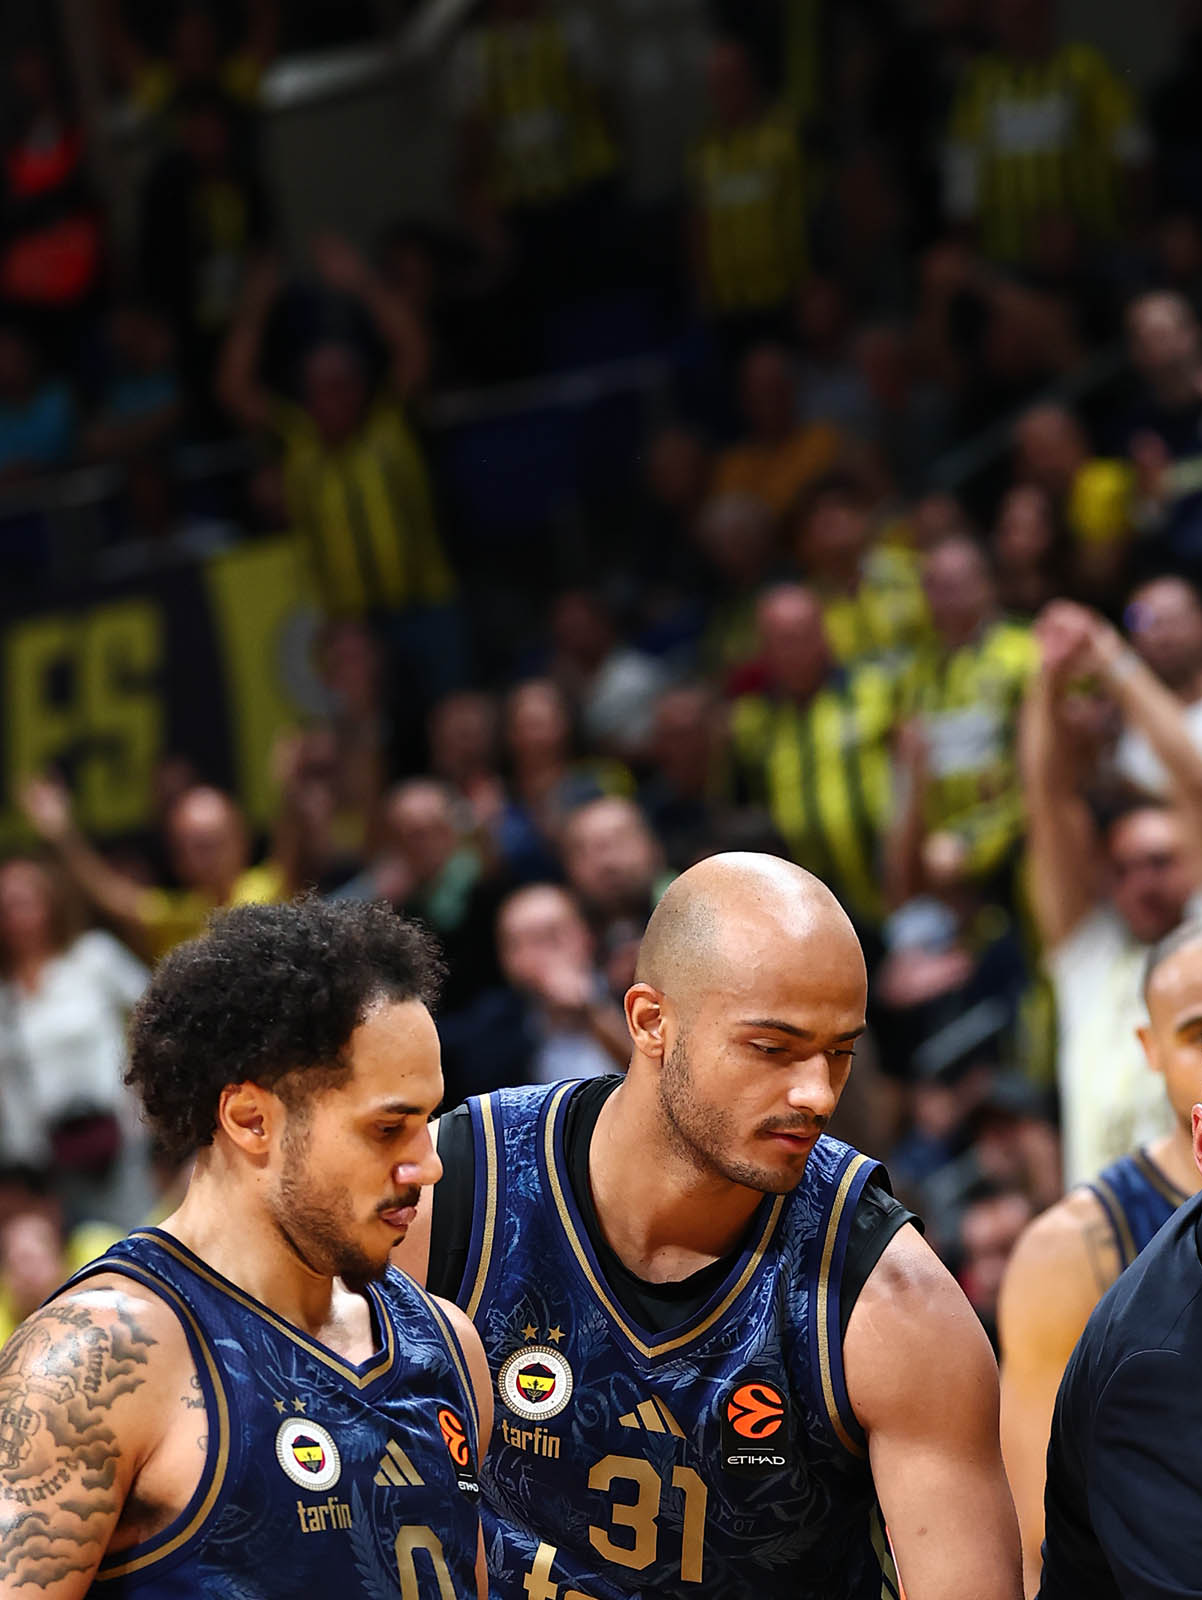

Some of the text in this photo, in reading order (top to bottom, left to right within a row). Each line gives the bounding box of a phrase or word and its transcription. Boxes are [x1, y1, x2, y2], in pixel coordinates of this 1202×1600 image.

[502, 1419, 560, 1459] tarfin
[727, 1455, 786, 1465] ETIHAD
[297, 1496, 352, 1534] tarfin
[587, 1454, 708, 1583] 31
